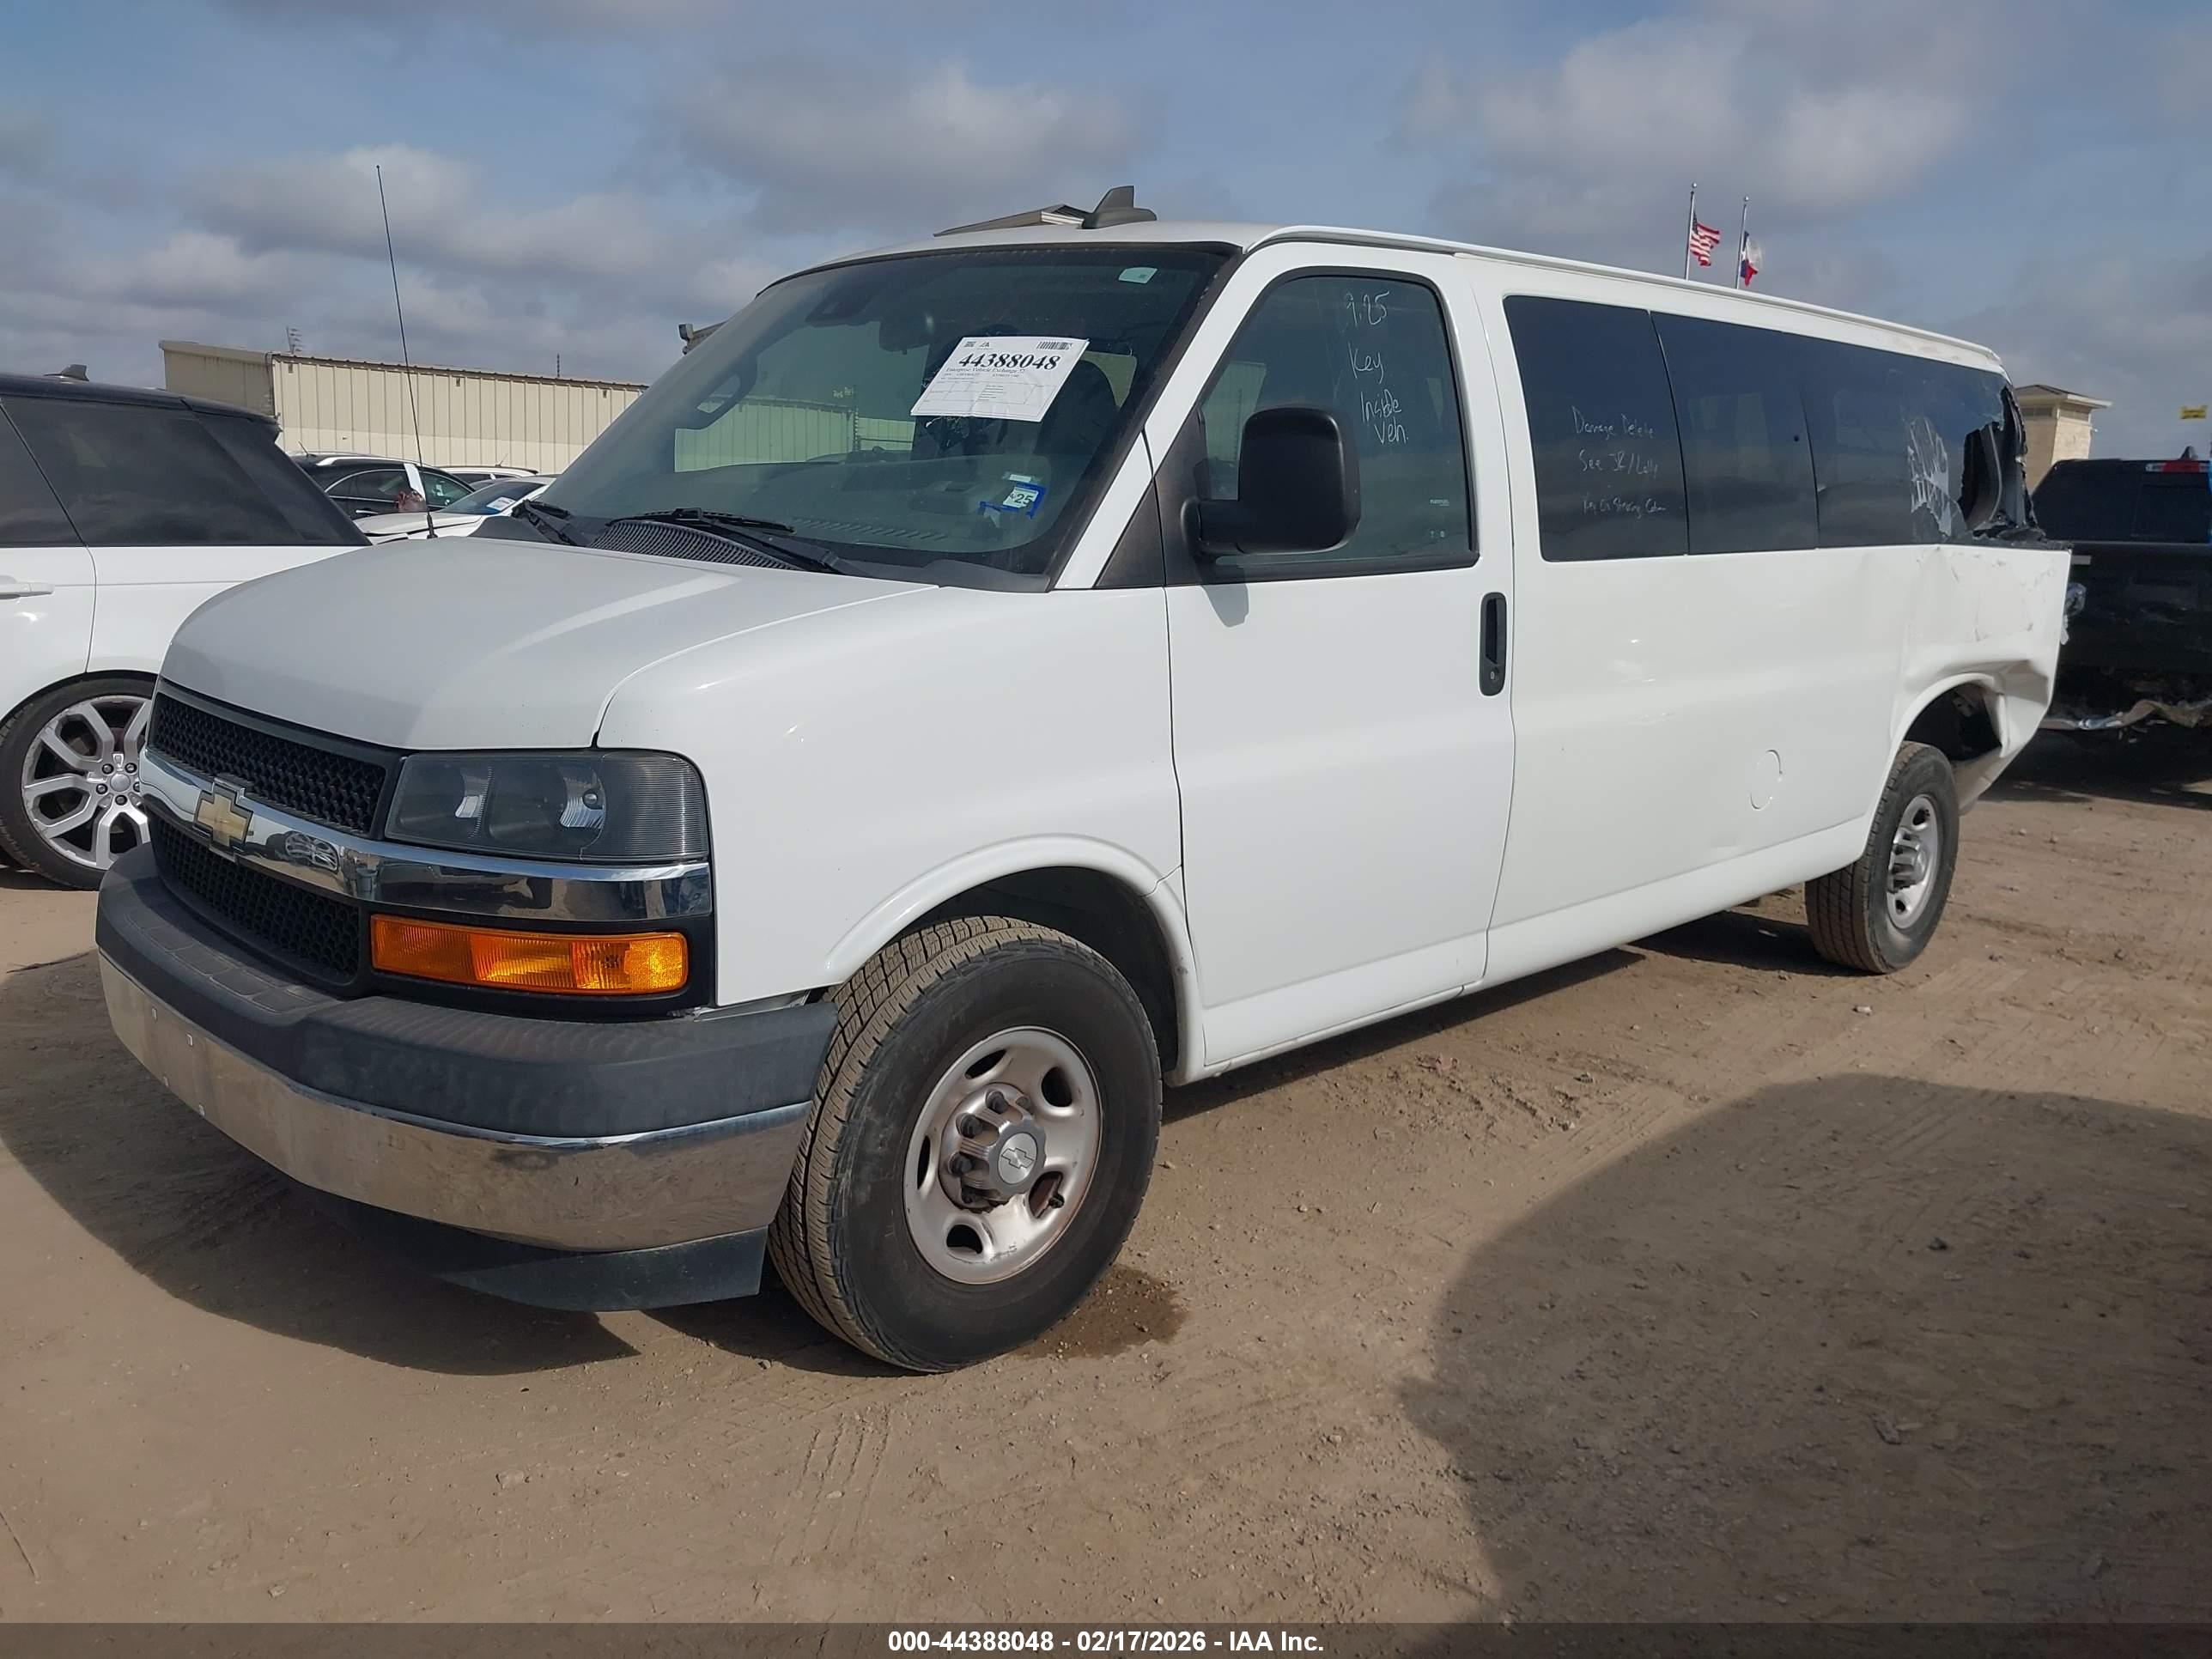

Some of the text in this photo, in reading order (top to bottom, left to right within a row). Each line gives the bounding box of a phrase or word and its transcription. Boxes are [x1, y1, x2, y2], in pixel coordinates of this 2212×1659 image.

[958, 353, 1061, 370] 44388048
[1348, 342, 1384, 384] Key
[1578, 448, 1603, 472] See
[1014, 494, 1034, 505] 25
